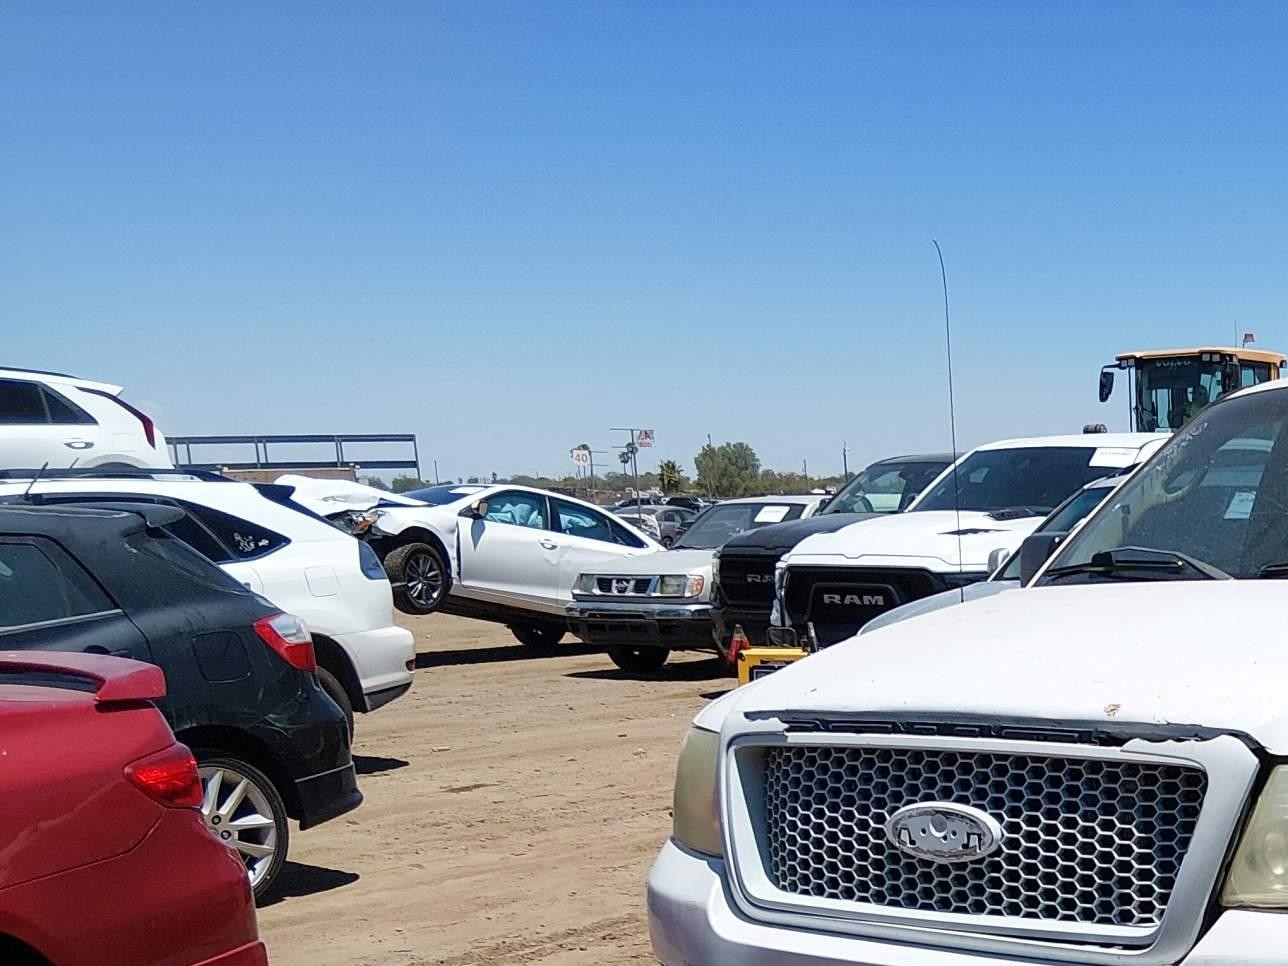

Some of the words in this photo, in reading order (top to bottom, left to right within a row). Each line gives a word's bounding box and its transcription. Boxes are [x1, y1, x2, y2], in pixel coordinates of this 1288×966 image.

[574, 453, 588, 463] 40
[746, 573, 775, 584] RA
[823, 593, 885, 606] RAM
